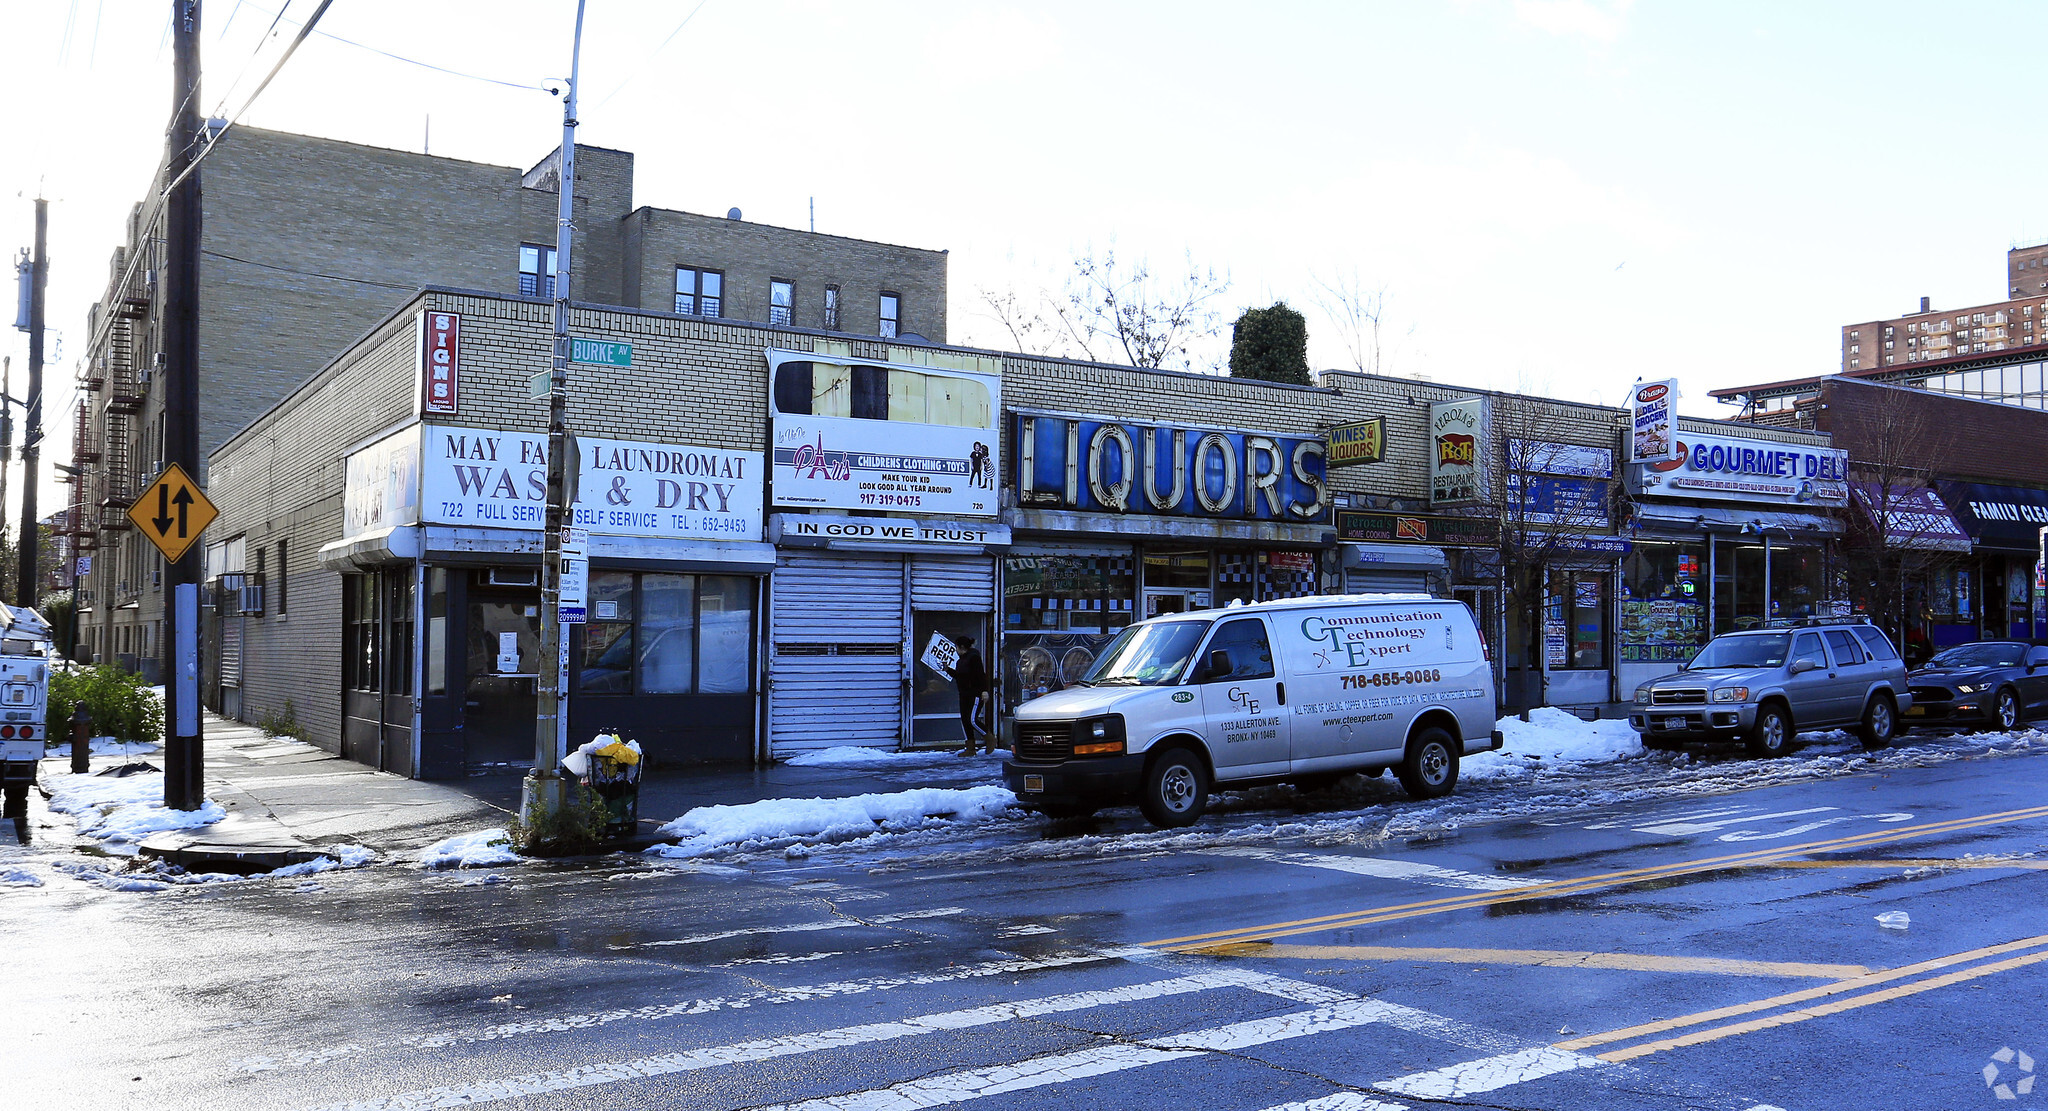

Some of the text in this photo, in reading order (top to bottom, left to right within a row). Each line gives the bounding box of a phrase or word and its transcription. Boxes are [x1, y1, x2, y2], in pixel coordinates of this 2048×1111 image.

[433, 315, 450, 398] SIGNS
[573, 341, 629, 362] BURKE AV
[1635, 408, 1668, 428] GROCERY
[1331, 425, 1374, 444] WINES &
[446, 434, 501, 461] MAY
[1330, 442, 1373, 460] LIQUORS
[592, 446, 746, 479] LAUNDROMAT
[858, 456, 965, 472] CHILDRENS CLOTHING TOYS
[1019, 416, 1327, 518] LIQUORS
[1693, 443, 1800, 476] GOURMET
[453, 465, 735, 512] WAS & DRY
[859, 482, 876, 490] LOOK
[877, 483, 894, 491] GOOD
[928, 486, 952, 494] AROUND
[882, 474, 899, 482] MAKE
[901, 475, 918, 483] YOUR
[1434, 472, 1475, 488] RESTAURANT
[860, 493, 921, 506] 917-319-0475
[442, 502, 463, 518] 722
[477, 504, 506, 519] FULL
[576, 509, 604, 525] SELF
[609, 511, 657, 528] SERVICE
[672, 514, 689, 530] TEL
[702, 517, 746, 533] 652-9453
[1969, 501, 2020, 521] FAMILY
[797, 523, 988, 542] IN GOD WE TRUST
[1348, 530, 1364, 538] HOME
[1366, 530, 1390, 540] COOKING
[1651, 606, 1675, 614] Gourmet
[1301, 610, 1443, 642] Communication
[938, 638, 956, 657] FOR
[1321, 626, 1427, 653] Technology
[930, 646, 955, 666] RENT
[1343, 641, 1411, 668] Expert
[1340, 669, 1441, 690] 718-655-9086
[1228, 687, 1261, 715] CTE
[1221, 721, 1235, 731] 1333
[1236, 718, 1267, 730] ALLERTON
[1322, 712, 1393, 727] www.cteexpert.com
[1032, 735, 1053, 745] GMC
[1251, 731, 1259, 741] NY
[1260, 729, 1276, 739] 10469
